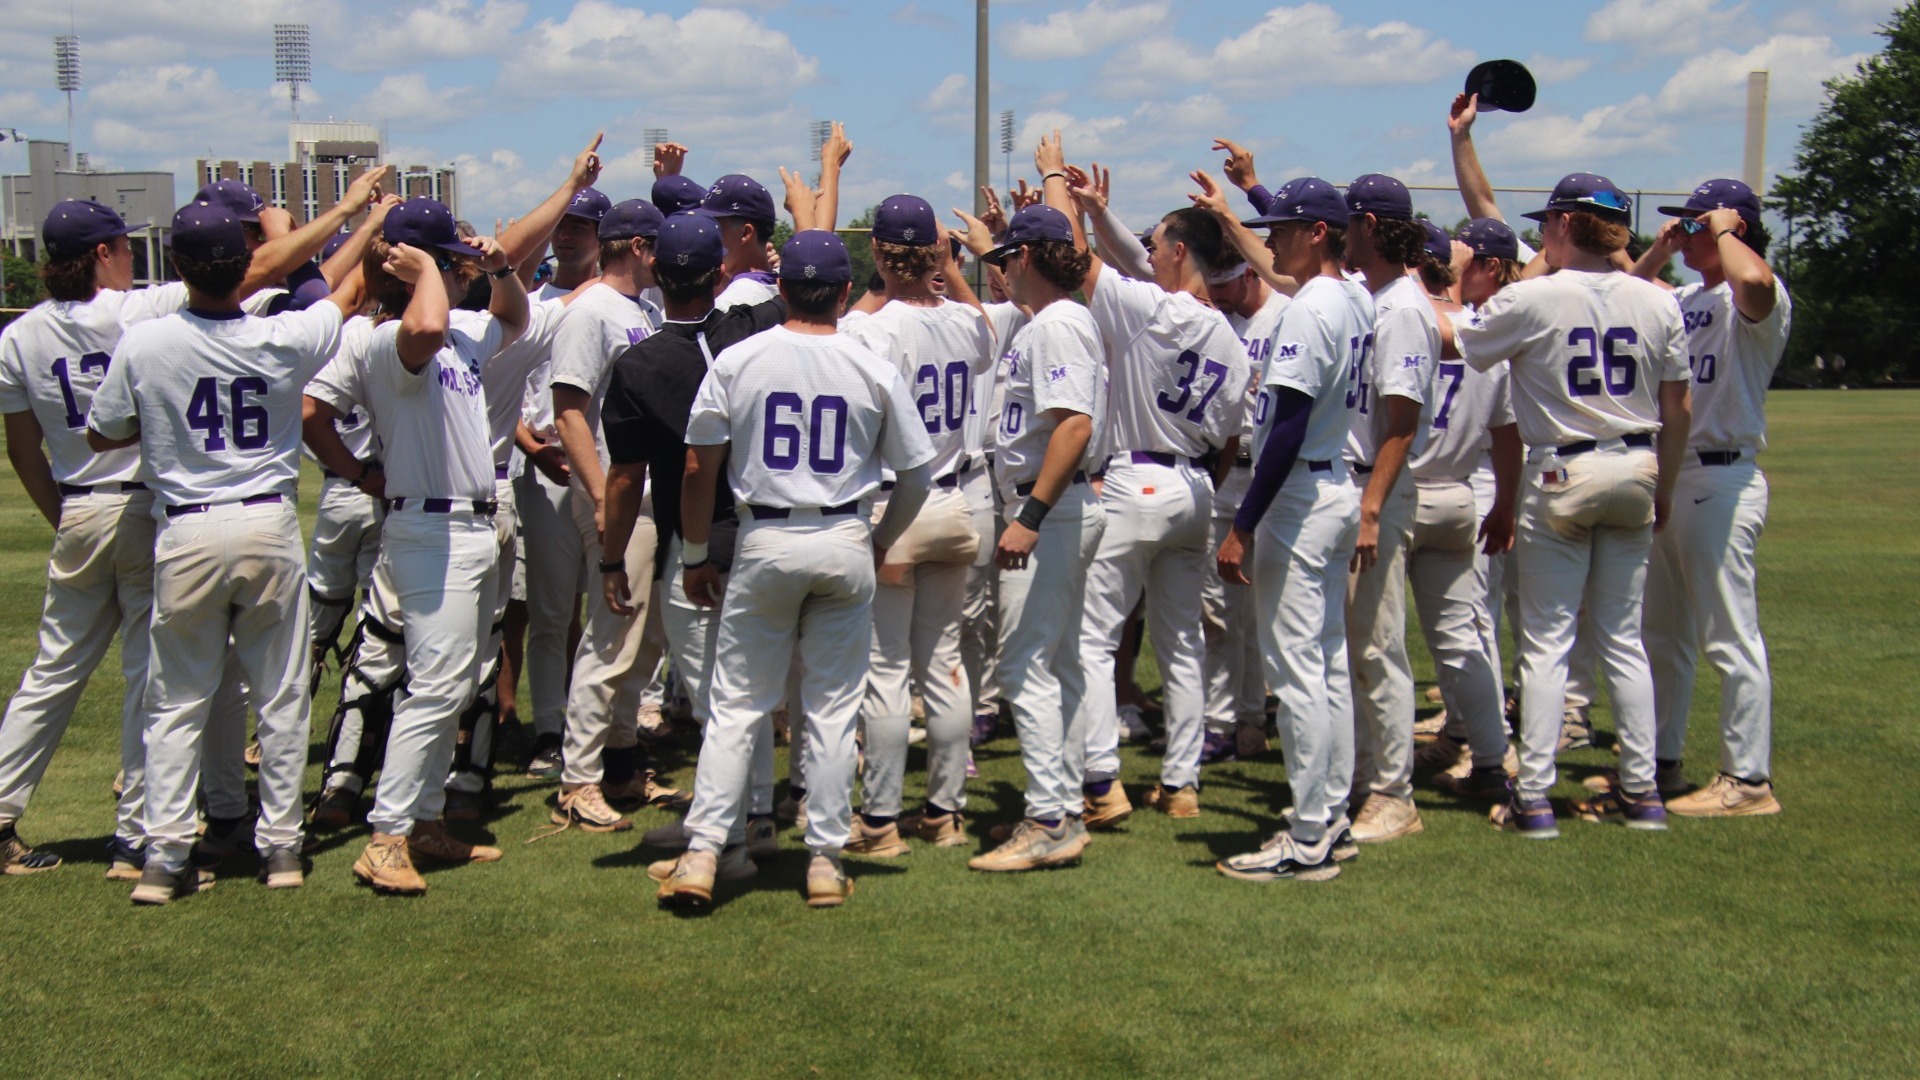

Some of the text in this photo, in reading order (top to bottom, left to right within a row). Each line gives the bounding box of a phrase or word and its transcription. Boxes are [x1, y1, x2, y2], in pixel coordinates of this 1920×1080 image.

[916, 360, 969, 434] 20
[1156, 349, 1229, 424] 37
[1567, 326, 1638, 398] 26
[185, 375, 270, 453] 46
[762, 391, 849, 475] 60
